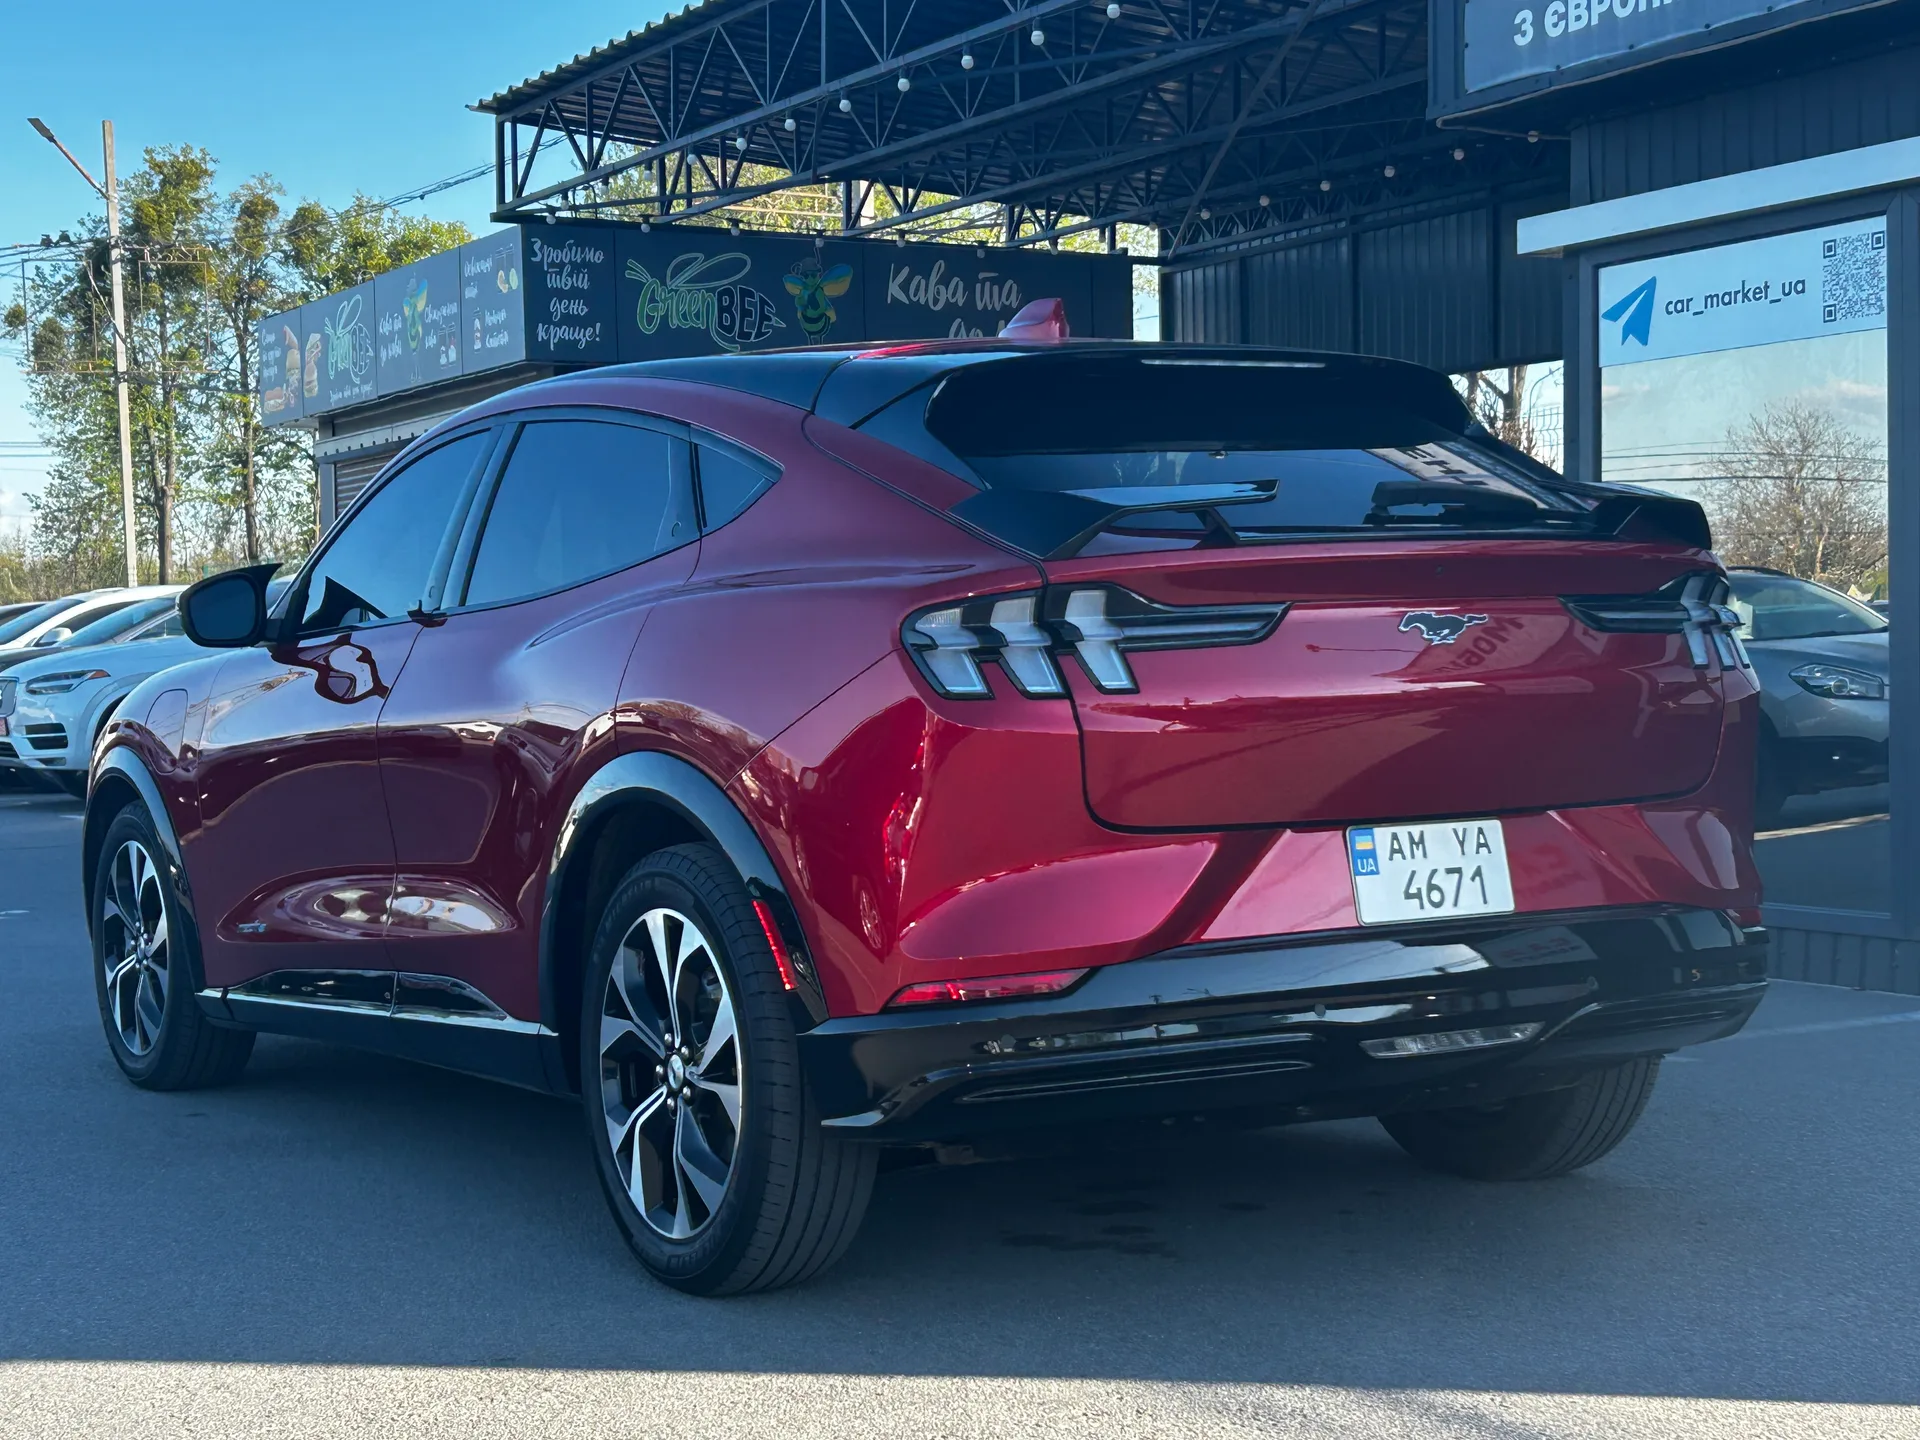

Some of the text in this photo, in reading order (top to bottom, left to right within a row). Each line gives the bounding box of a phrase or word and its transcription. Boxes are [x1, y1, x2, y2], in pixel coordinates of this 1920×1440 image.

[1513, 0, 1673, 46] З ЄВРО
[530, 238, 605, 271] Зробимо
[547, 264, 591, 290] твій
[887, 259, 1022, 312] Кава та
[549, 297, 588, 321] день
[1664, 278, 1806, 316] car_market_ua
[536, 322, 601, 351] краще!
[1388, 826, 1492, 861] AM YA
[1357, 858, 1377, 873] UA
[1403, 864, 1488, 910] 4671
